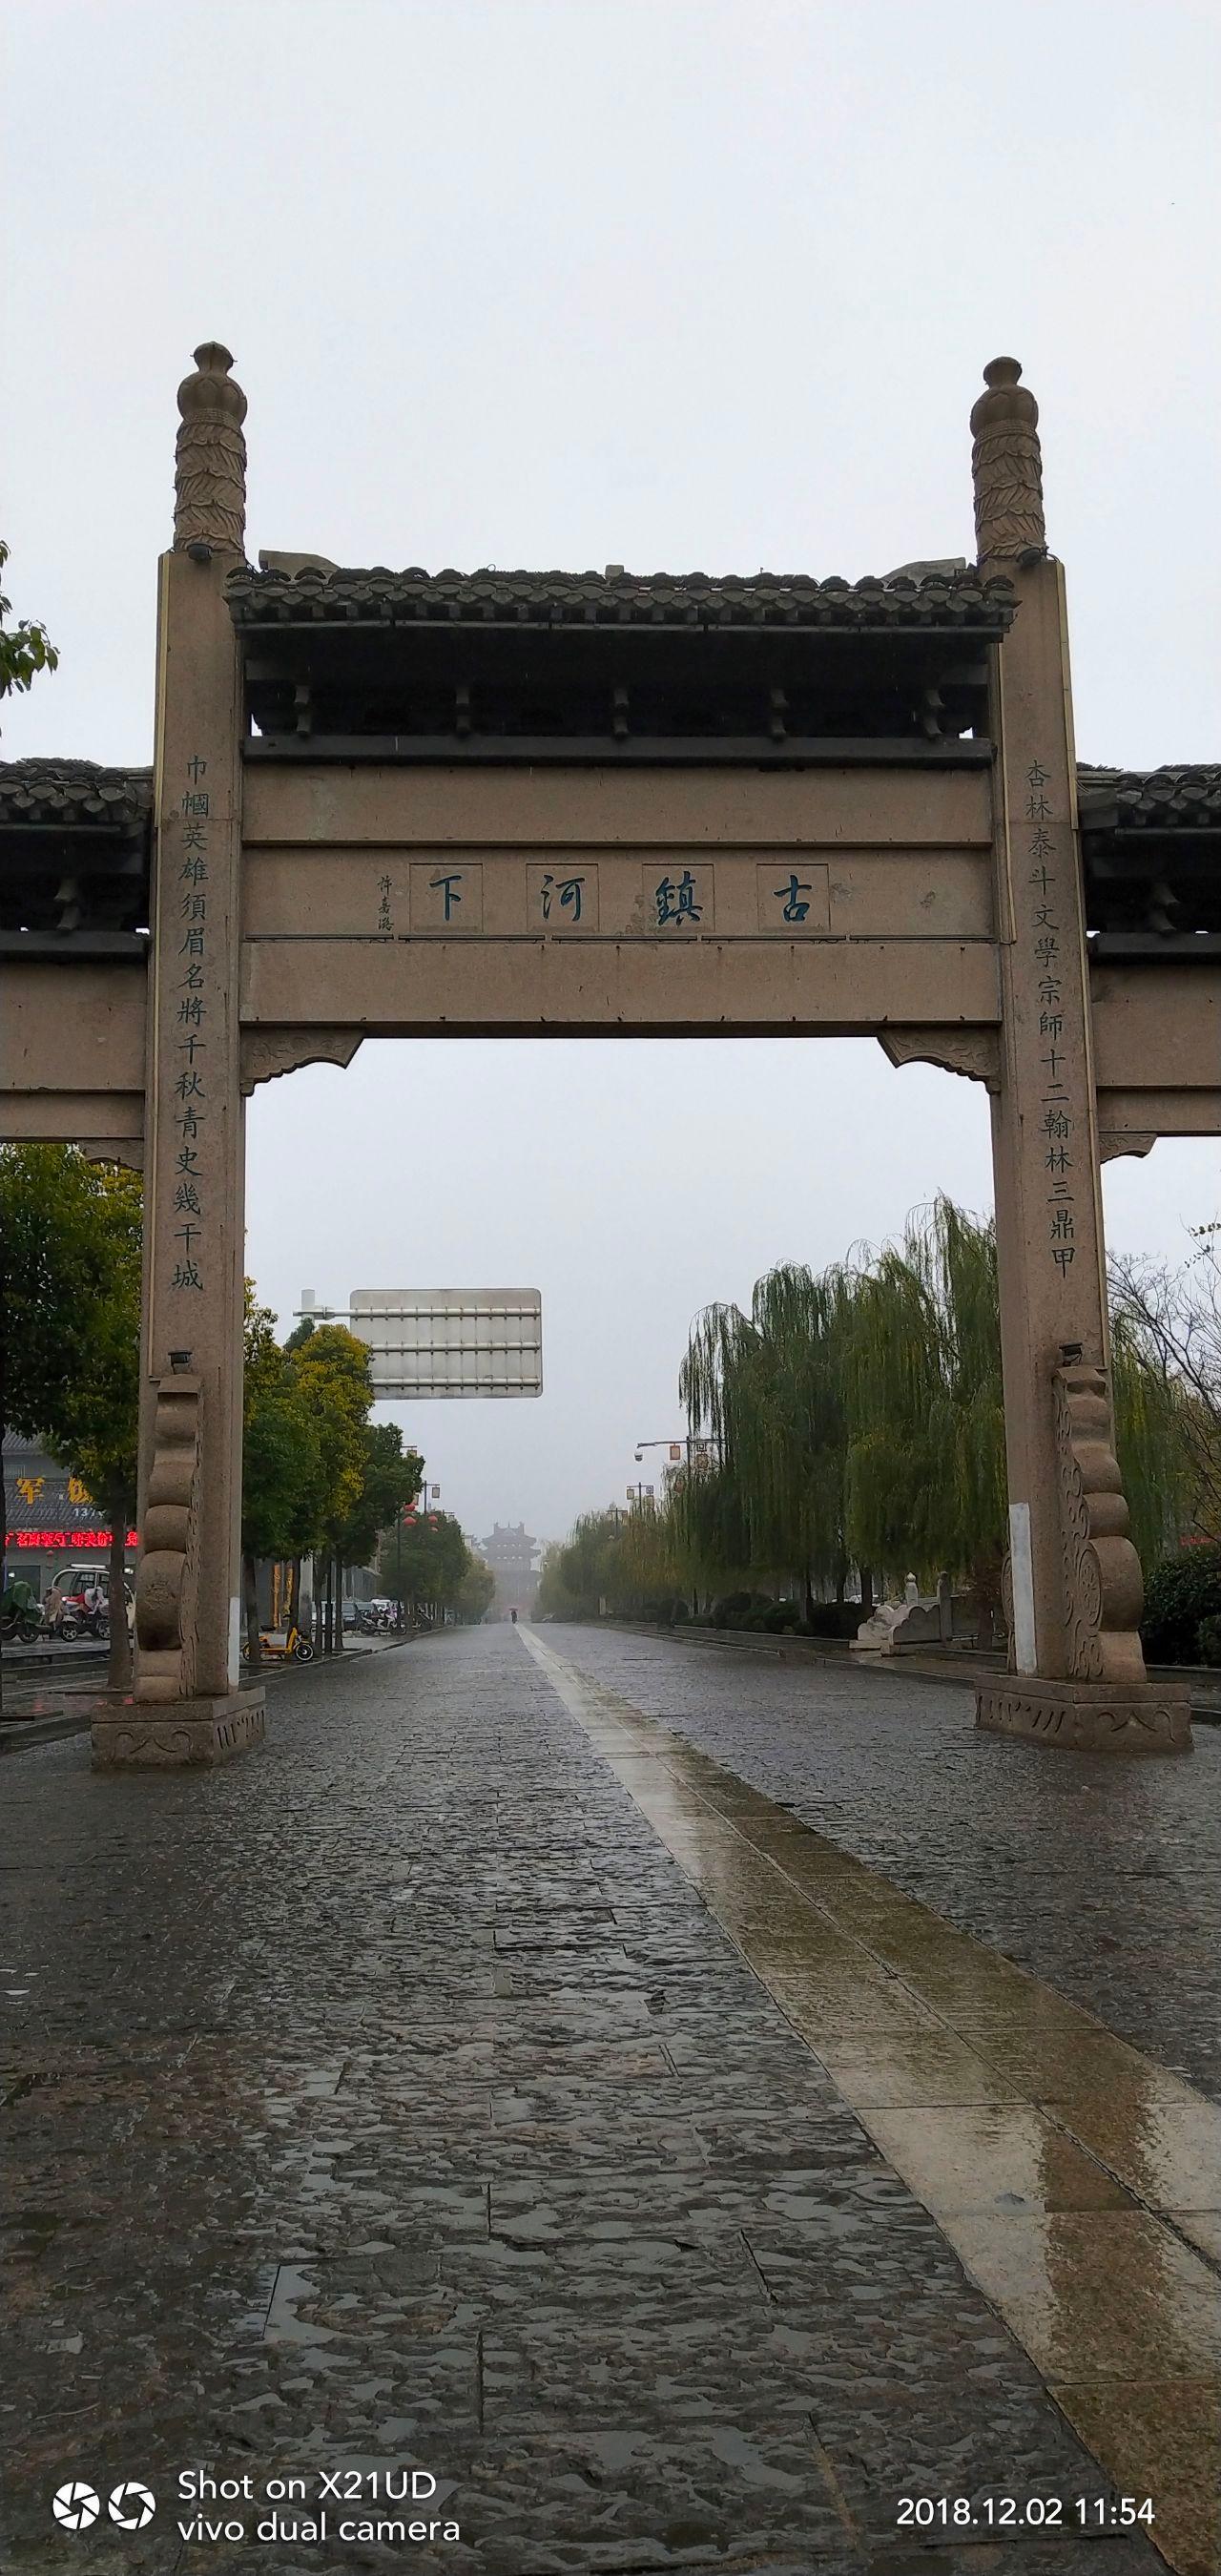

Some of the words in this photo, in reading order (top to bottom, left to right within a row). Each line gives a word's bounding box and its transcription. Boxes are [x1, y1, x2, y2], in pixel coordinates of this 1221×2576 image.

[1024, 759, 1076, 1278] 杏林泰斗文學宗師十二翰林三鼎甲
